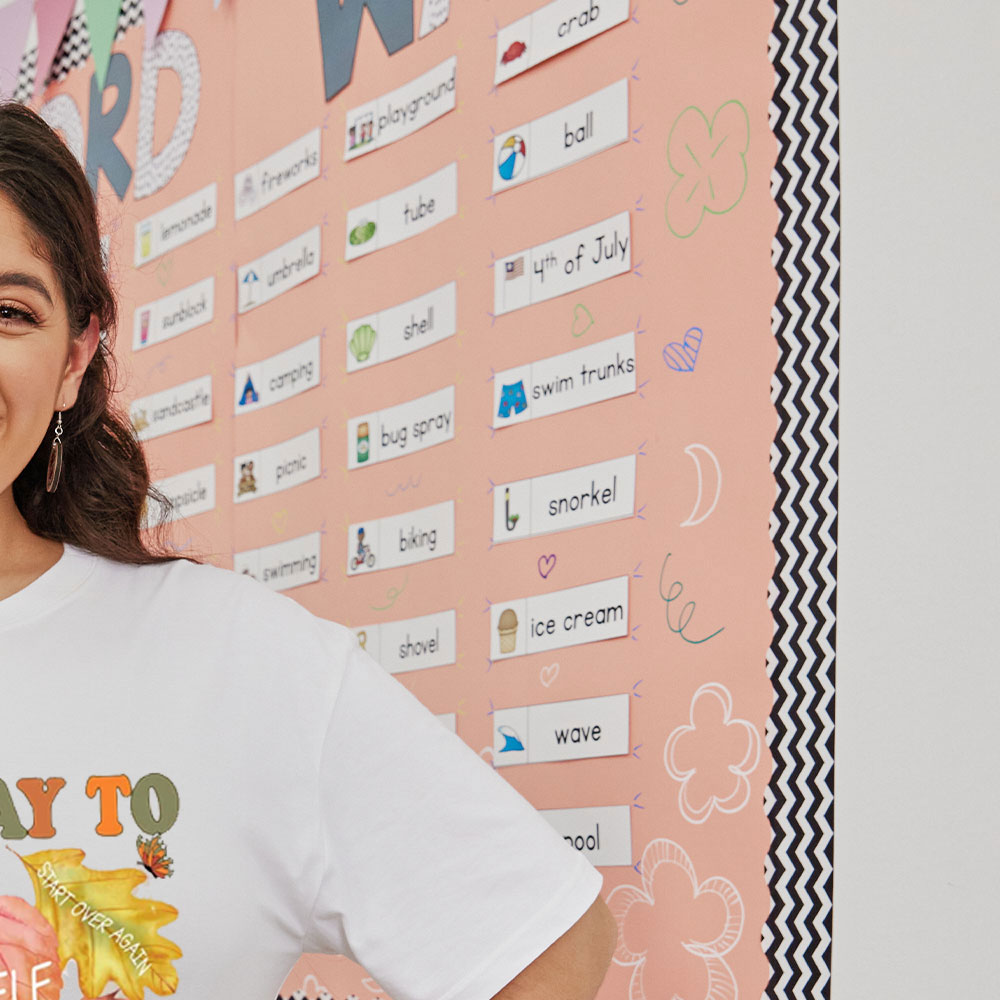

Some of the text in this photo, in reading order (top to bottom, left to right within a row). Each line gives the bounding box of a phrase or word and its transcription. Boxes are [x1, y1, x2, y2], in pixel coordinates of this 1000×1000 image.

[557, 0, 600, 38] crab
[377, 67, 457, 134] playground
[564, 111, 595, 150] ball
[259, 148, 319, 194] fireworks
[160, 200, 213, 241] lemonade
[403, 195, 436, 225] tube
[266, 247, 315, 287] umbrella
[533, 231, 629, 283] 4th of July
[161, 292, 208, 330] sunblock
[403, 306, 435, 341] shell
[268, 361, 314, 392] camping
[531, 352, 636, 401] swim trunks
[380, 410, 452, 449] bug spray
[275, 455, 308, 486] picnic
[548, 475, 617, 518] snorkel
[398, 526, 438, 554] biking
[262, 554, 318, 584] swimming
[530, 601, 624, 639] ice cream
[398, 628, 440, 660] shovel
[554, 723, 602, 746] wave
[85, 772, 181, 836] TO
[37, 861, 152, 977] START OVER AGAIN
